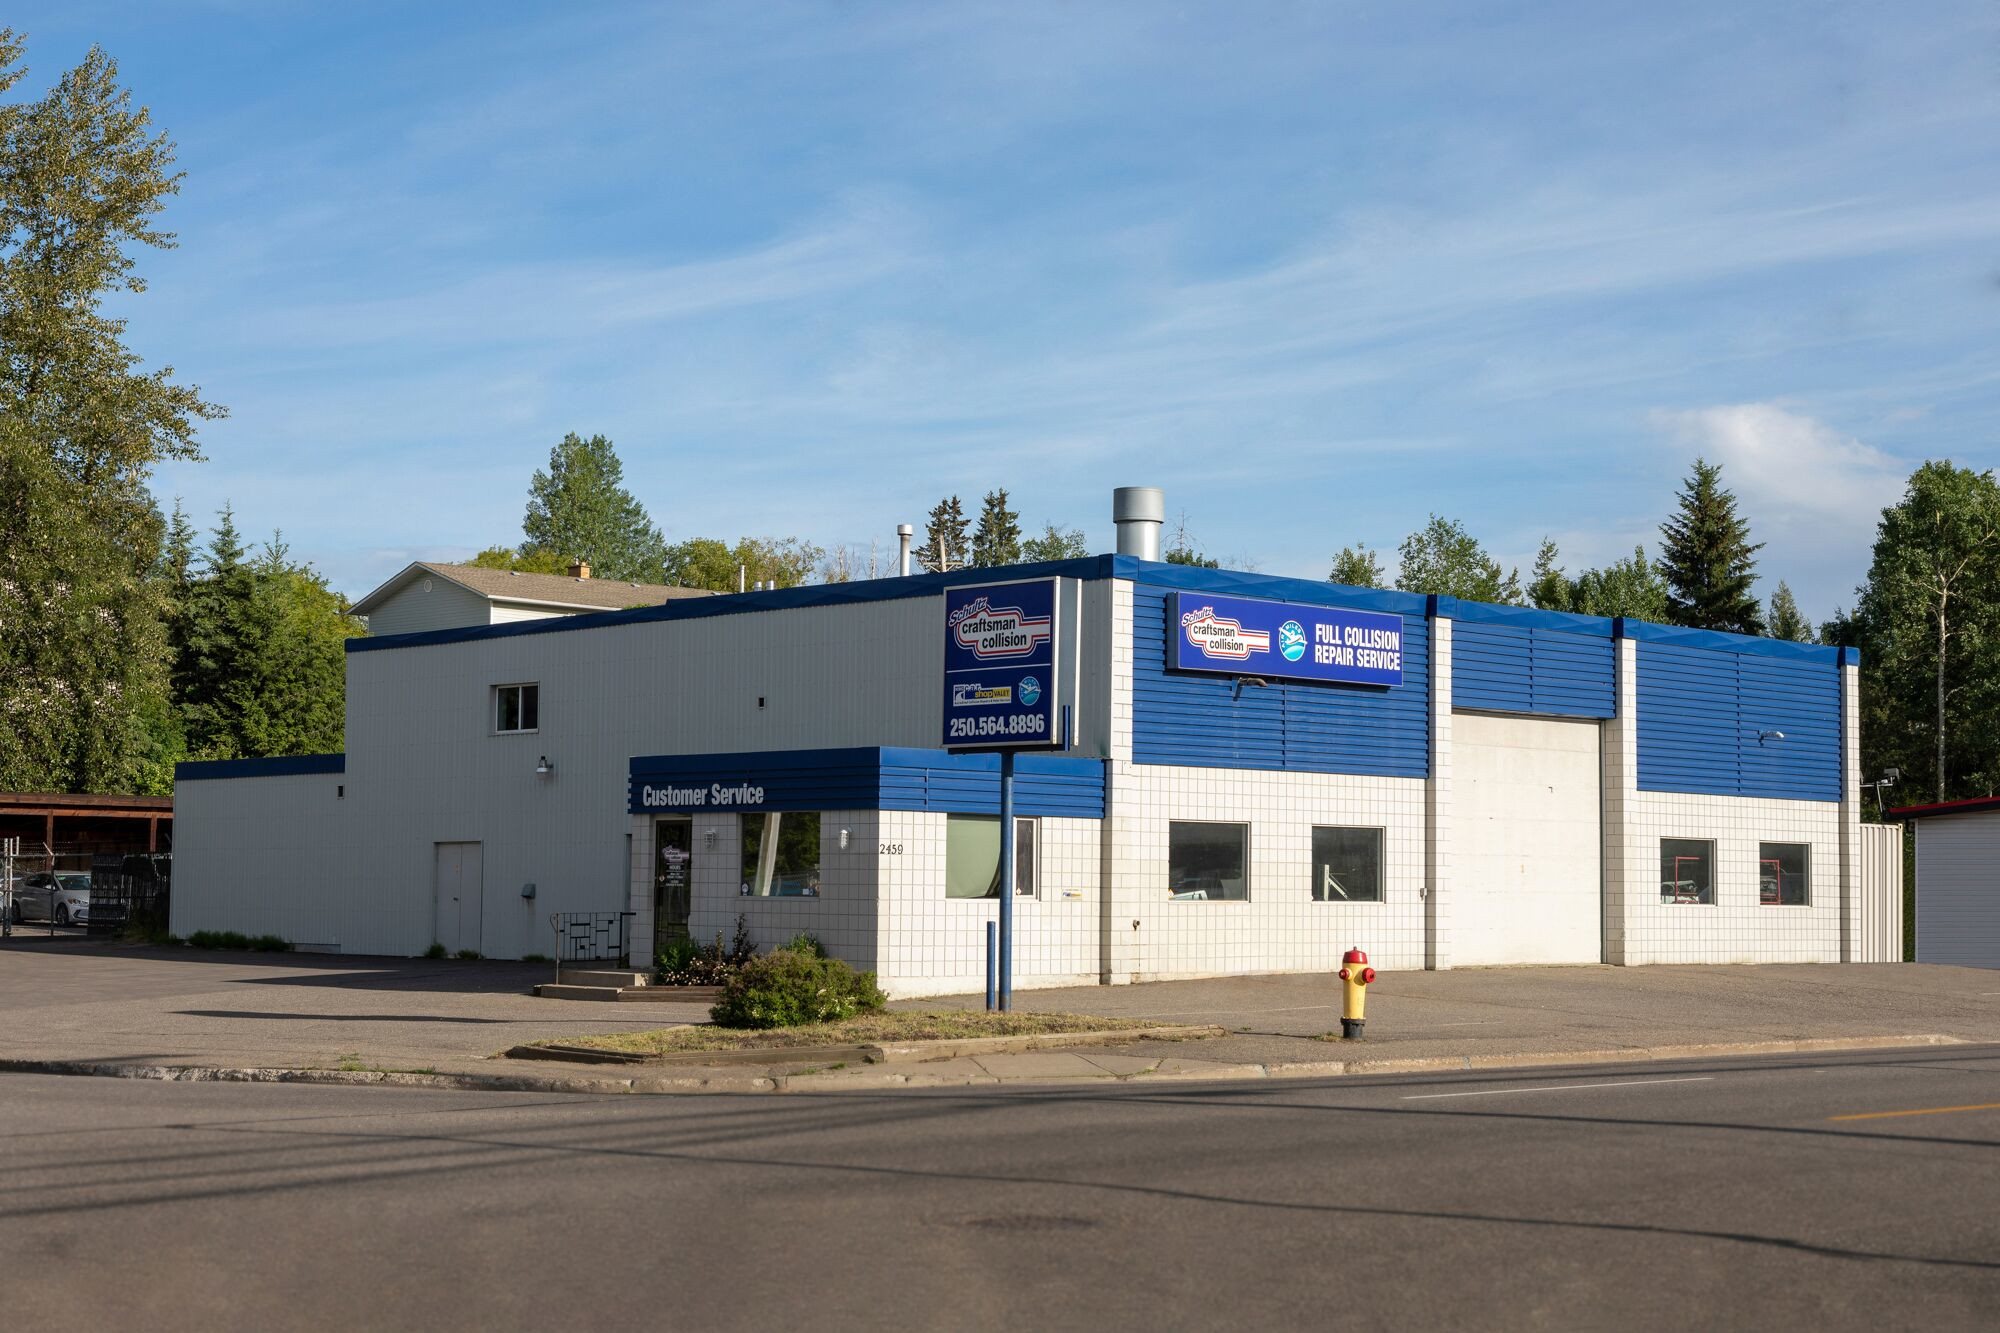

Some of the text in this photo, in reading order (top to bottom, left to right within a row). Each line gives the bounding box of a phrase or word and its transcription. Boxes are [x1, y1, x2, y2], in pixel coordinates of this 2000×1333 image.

[949, 597, 988, 626] Schultz
[1182, 606, 1213, 626] Schultz
[962, 618, 1016, 634] craftsman
[1193, 623, 1235, 638] craftsman
[982, 632, 1027, 649] collision
[1209, 638, 1244, 652] collision
[1315, 623, 1400, 651] FULL COLLISION
[1315, 644, 1401, 671] REPAIR SERVICE
[975, 690, 993, 698] shop
[950, 714, 1045, 737] 250.564.8896
[643, 783, 764, 806] Customer Service
[880, 844, 904, 855] 2459
